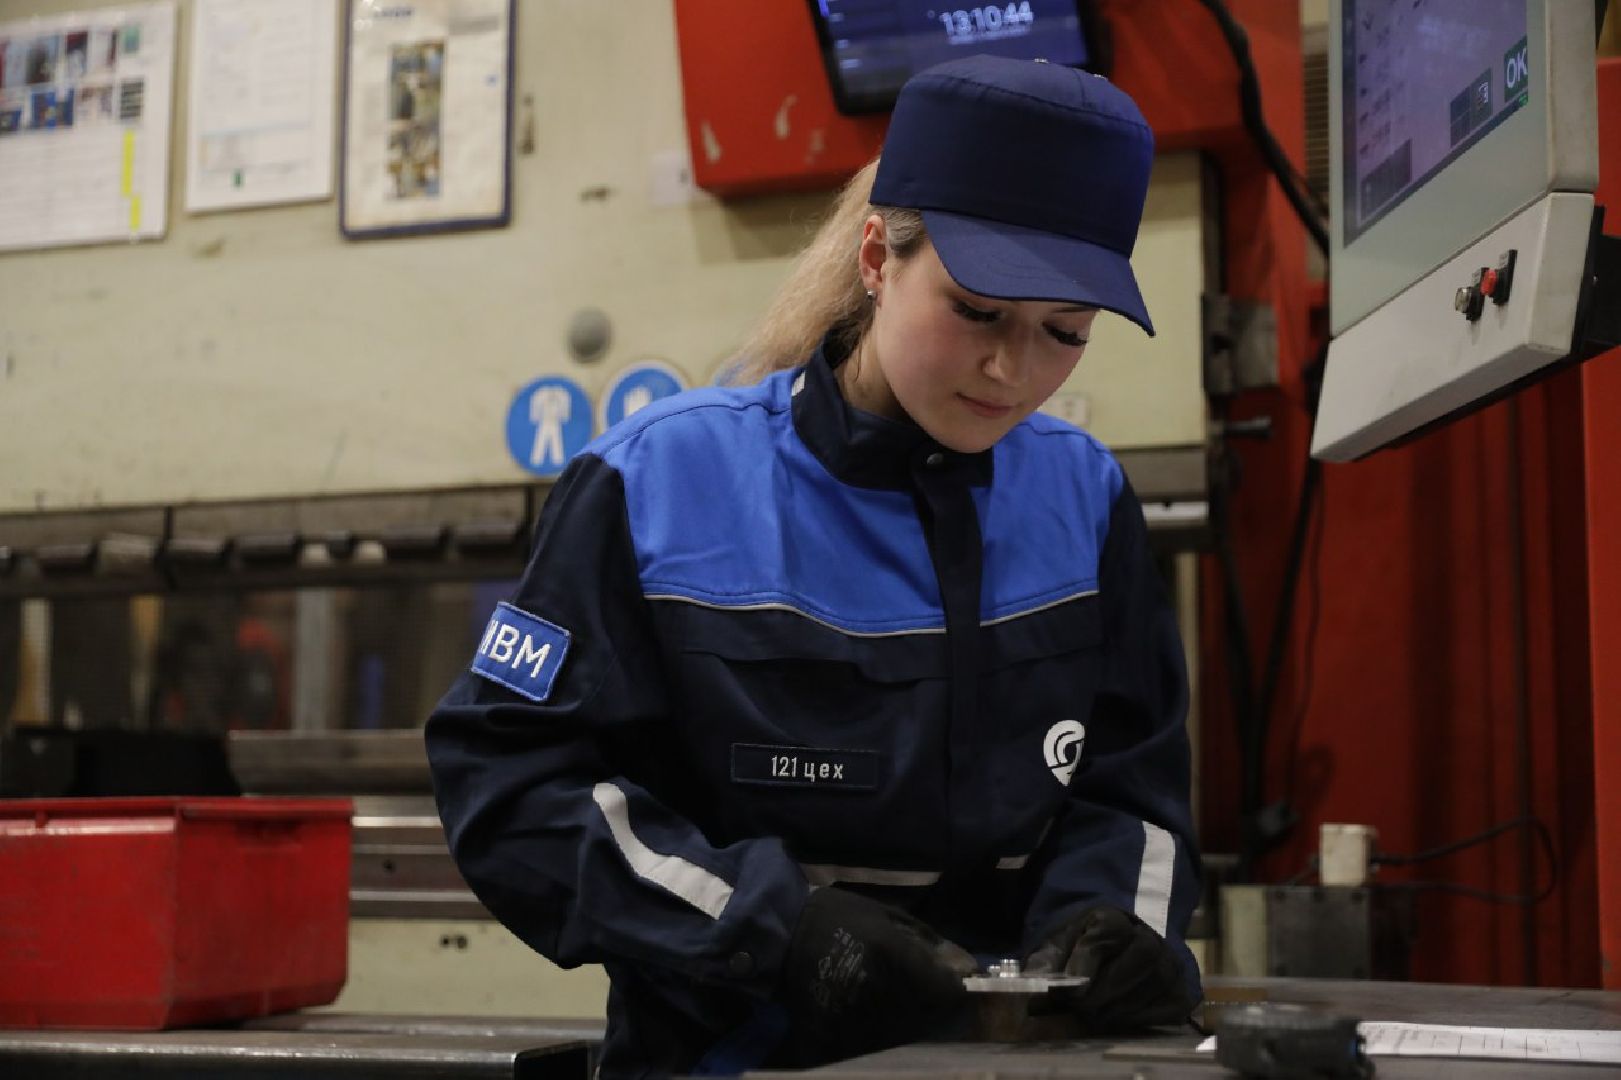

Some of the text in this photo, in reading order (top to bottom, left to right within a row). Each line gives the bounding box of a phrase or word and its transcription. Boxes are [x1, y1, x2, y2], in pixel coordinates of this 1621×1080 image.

[1507, 47, 1529, 88] OK
[771, 755, 844, 782] 121 цех
